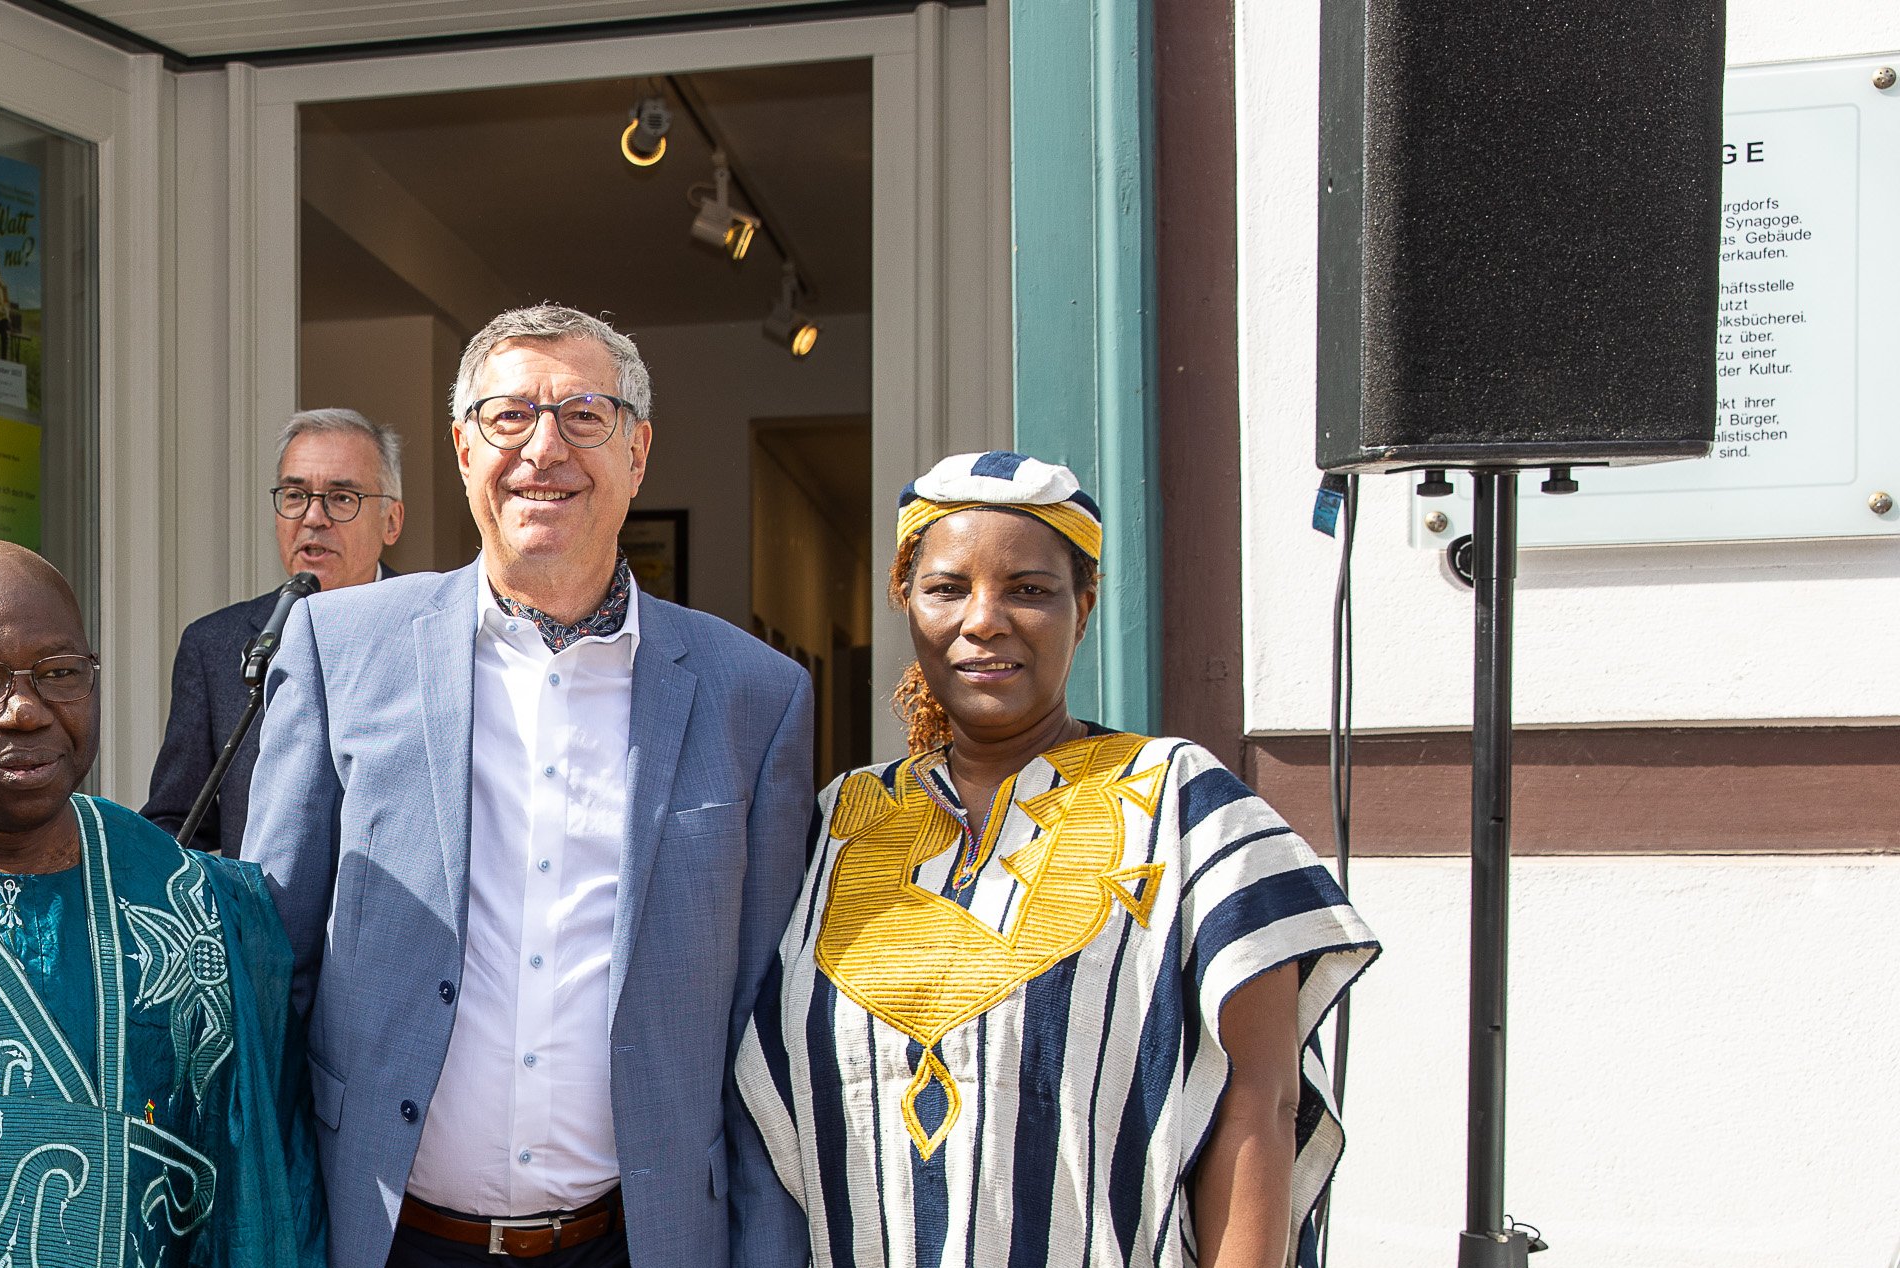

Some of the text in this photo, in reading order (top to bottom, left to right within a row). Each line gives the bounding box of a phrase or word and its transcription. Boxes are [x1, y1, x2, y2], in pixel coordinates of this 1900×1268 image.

[1725, 214, 1802, 232] Synagoge.
[1745, 228, 1812, 244] Gebäude
[1719, 246, 1788, 262] erkaufen.
[1720, 279, 1795, 295] häftsstelle
[1720, 299, 1748, 312] utzt
[1740, 331, 1774, 344] über.
[1717, 347, 1777, 361] zu einer
[1718, 363, 1792, 377] der Kultur.
[1744, 396, 1776, 408] ihrer
[1730, 412, 1780, 428] Bürger,
[1714, 429, 1788, 443] alistischen
[1719, 445, 1751, 459] sind.
